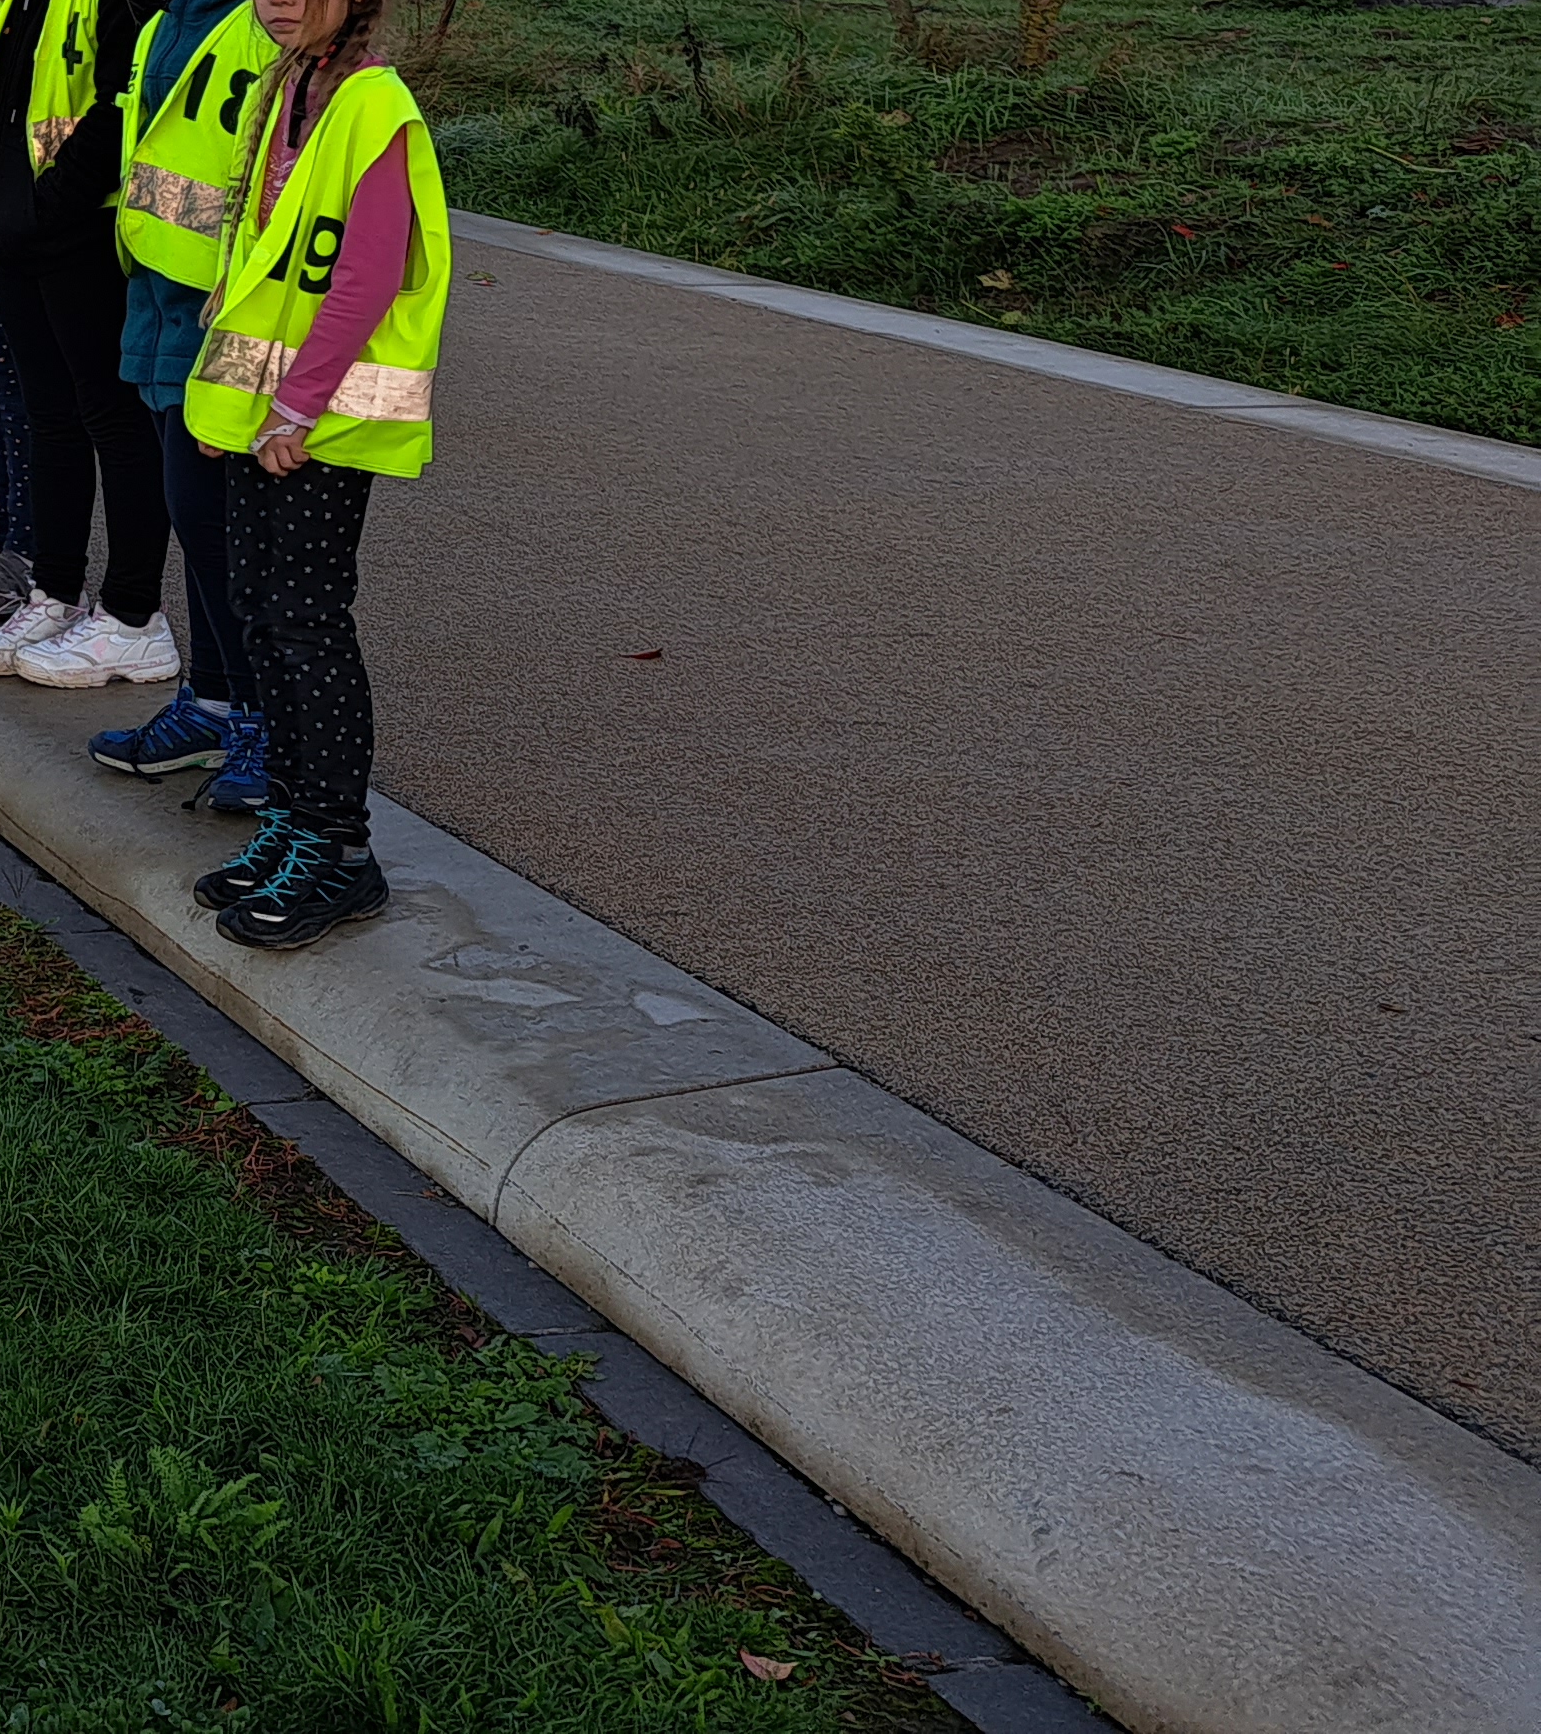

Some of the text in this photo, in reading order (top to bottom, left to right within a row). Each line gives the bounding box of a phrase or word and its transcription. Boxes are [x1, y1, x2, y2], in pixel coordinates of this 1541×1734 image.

[61, 11, 84, 76] 4
[182, 52, 262, 136] 18
[266, 205, 346, 295] 19
